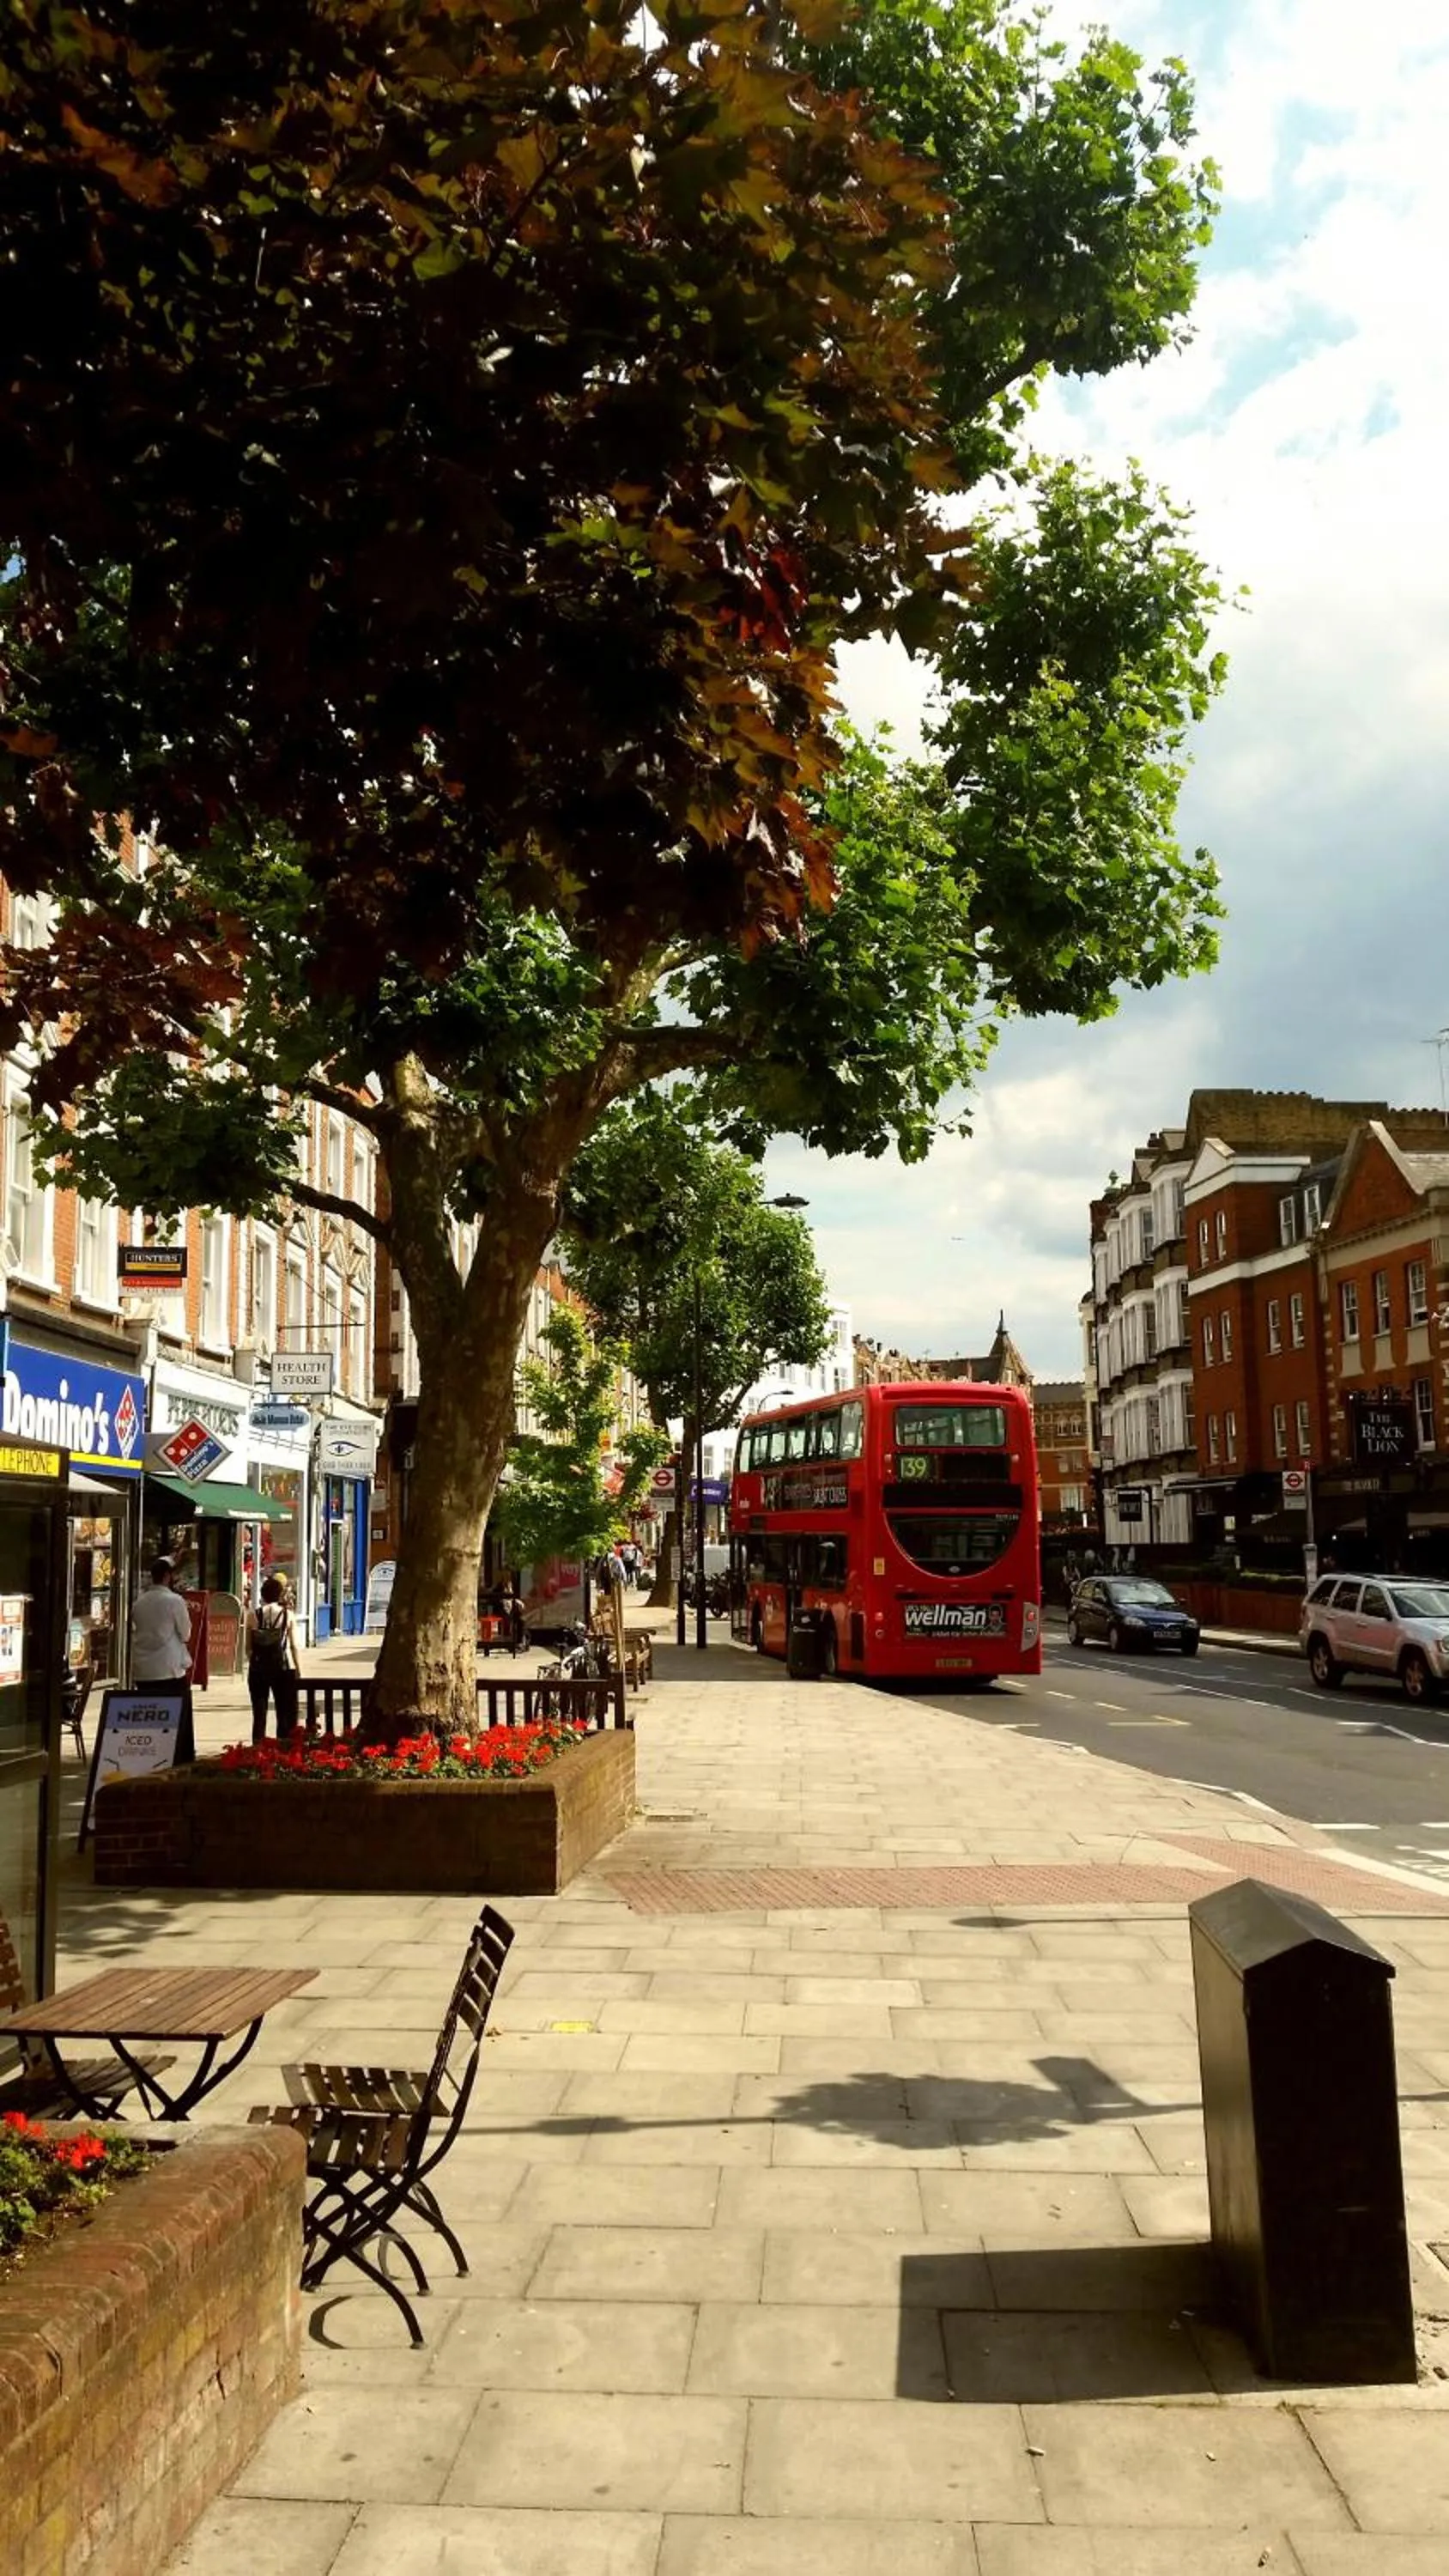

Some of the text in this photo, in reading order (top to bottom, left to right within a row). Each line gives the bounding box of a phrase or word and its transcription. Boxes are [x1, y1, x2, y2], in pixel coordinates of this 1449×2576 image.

[129, 1254, 178, 1262] HUNTERS
[277, 1363, 326, 1372] HEALTH
[281, 1375, 321, 1384] STORE
[3, 1370, 110, 1455] Domino's
[1361, 1423, 1404, 1438] BLACK
[1367, 1438, 1399, 1453] LION
[901, 1457, 927, 1478] 139
[906, 1604, 986, 1625] wellman
[118, 1709, 169, 1722] NERO
[125, 1735, 152, 1746] ICED
